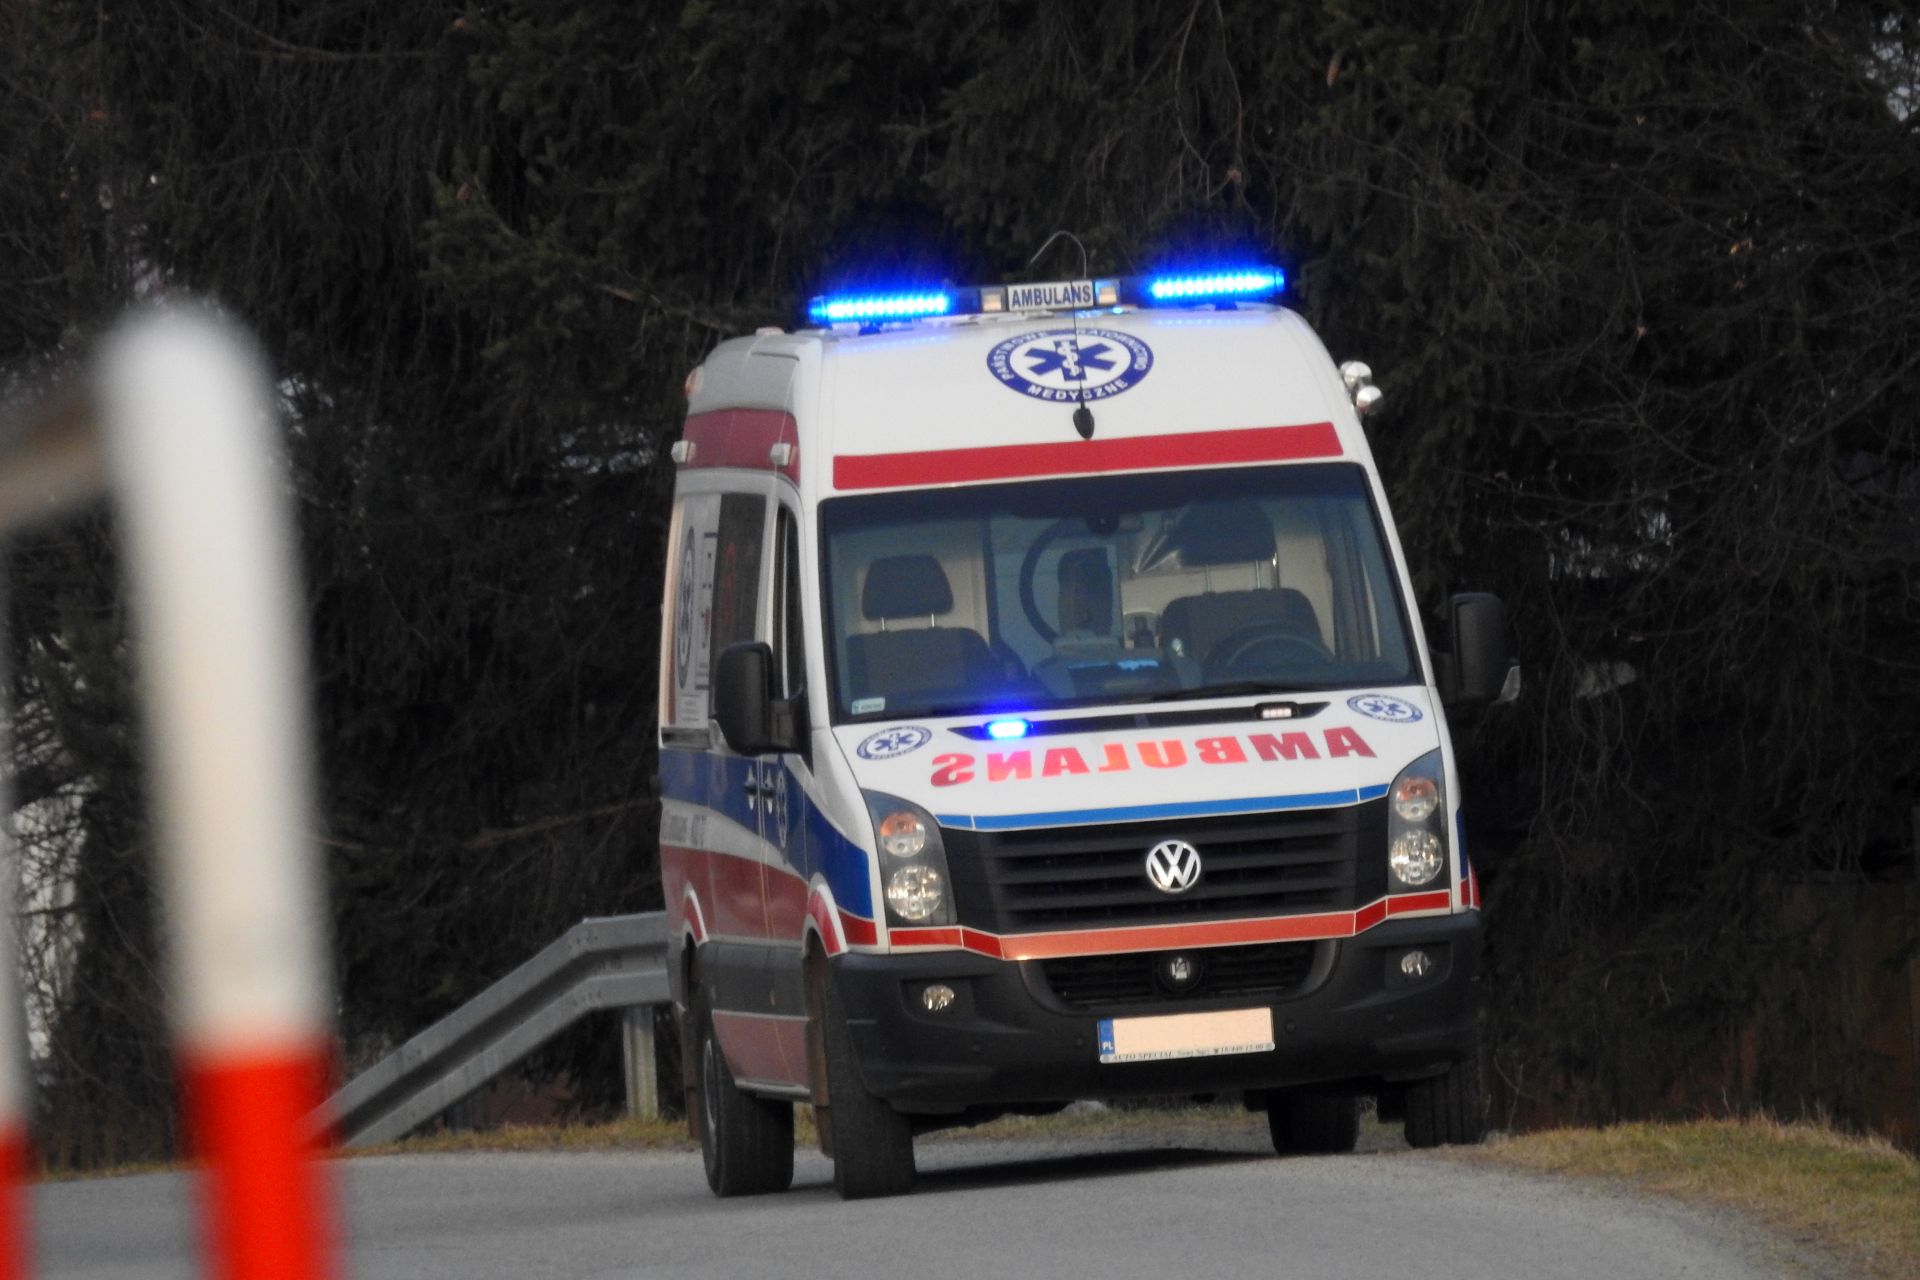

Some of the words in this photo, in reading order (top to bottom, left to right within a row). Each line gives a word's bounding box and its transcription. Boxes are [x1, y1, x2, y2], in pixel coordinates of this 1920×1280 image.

[1012, 285, 1091, 307] AMBULANS
[1028, 379, 1128, 401] MEDYCZNE
[1102, 1041, 1114, 1051] PL
